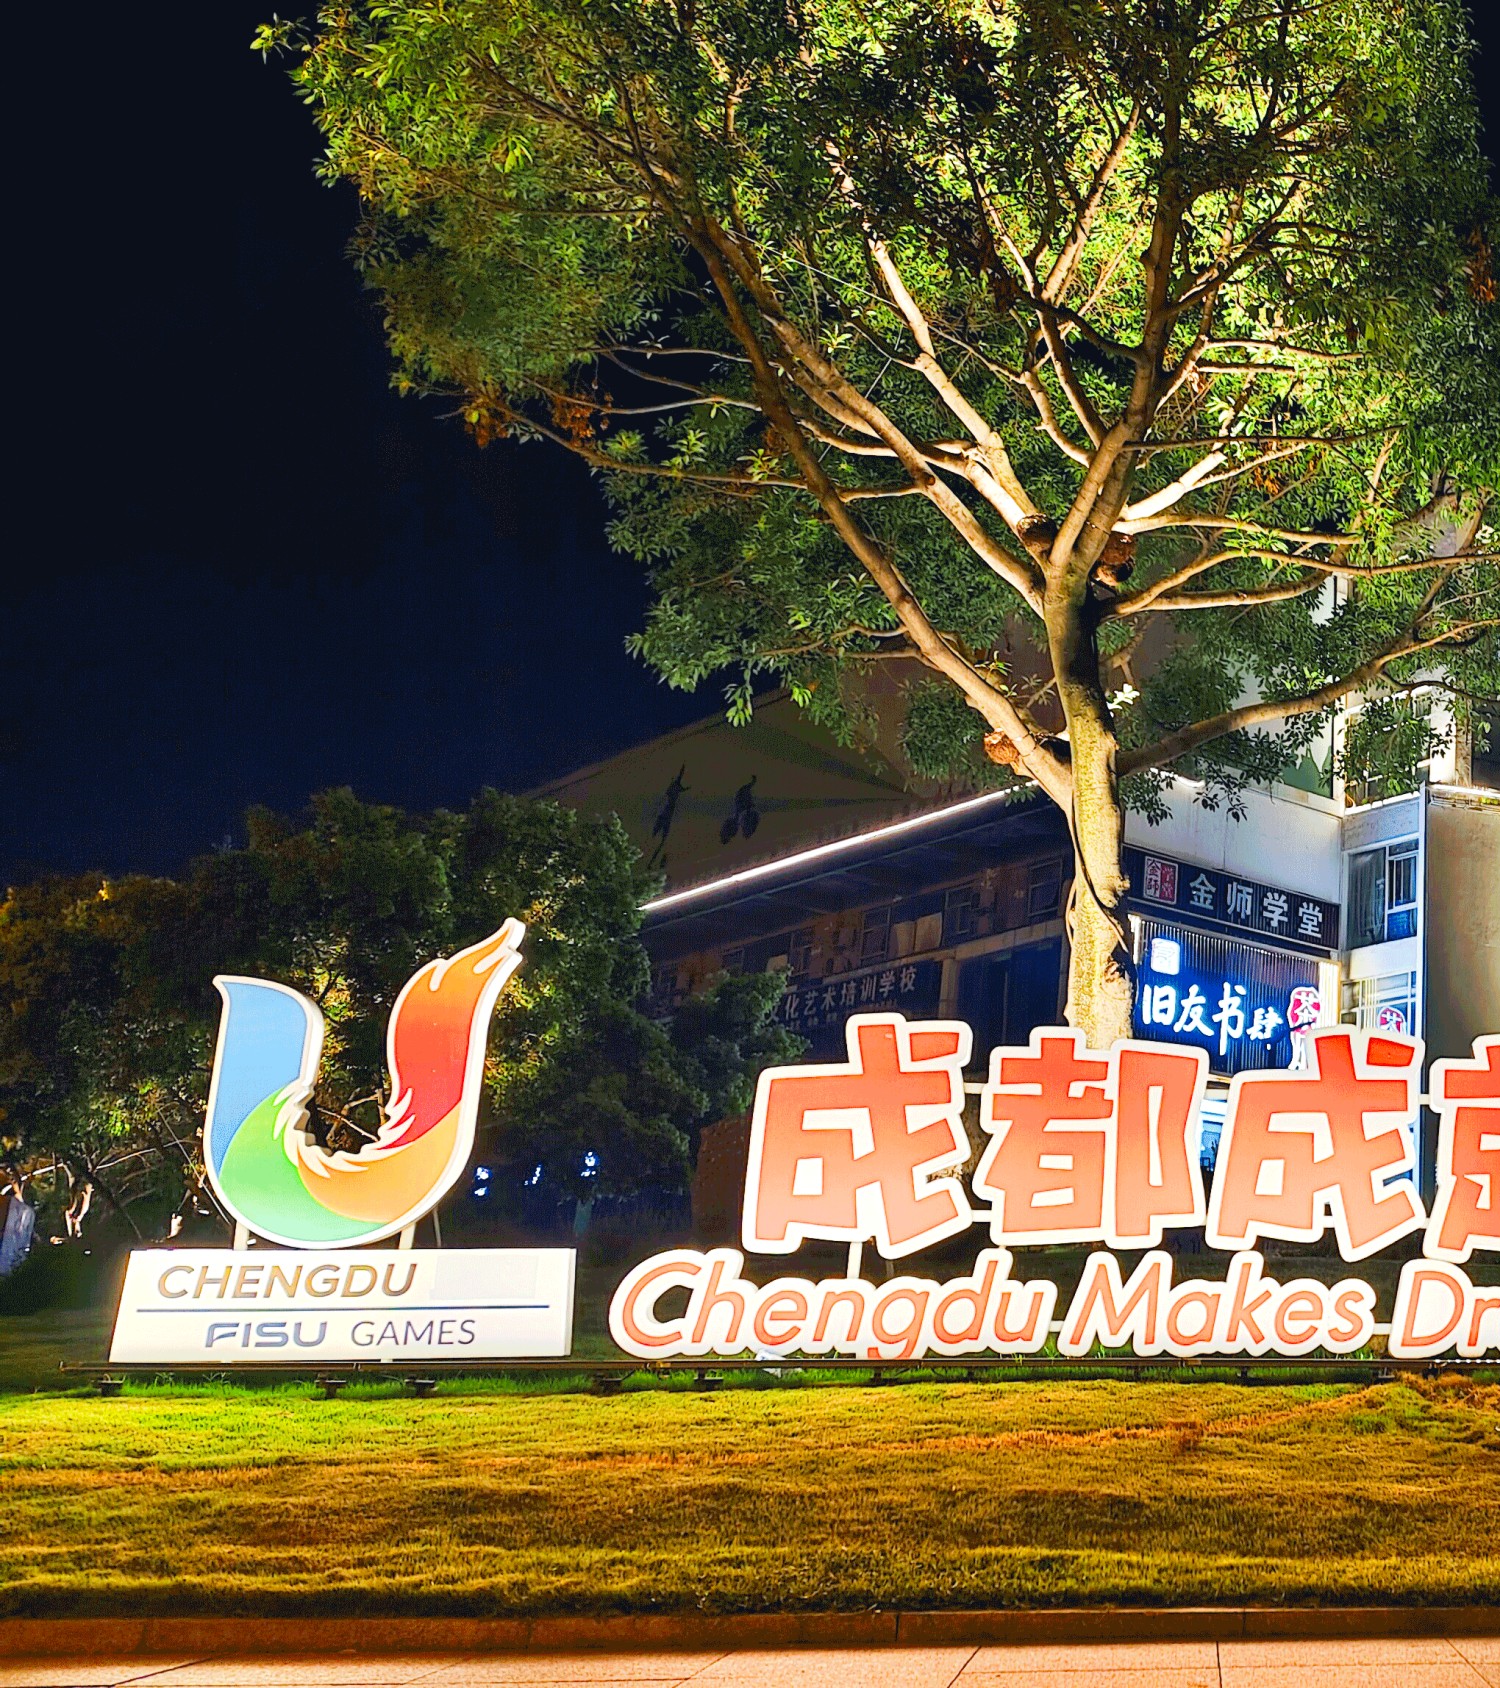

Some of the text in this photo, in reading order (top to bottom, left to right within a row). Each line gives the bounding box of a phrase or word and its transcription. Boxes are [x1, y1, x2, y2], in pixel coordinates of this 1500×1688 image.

[1189, 873, 1323, 939] 金师学堂
[158, 1263, 418, 1299] CHENGDU
[204, 1319, 476, 1349] FISU GAMES
[621, 1259, 1046, 1360] Chengdu
[1069, 1262, 1366, 1347] Makes
